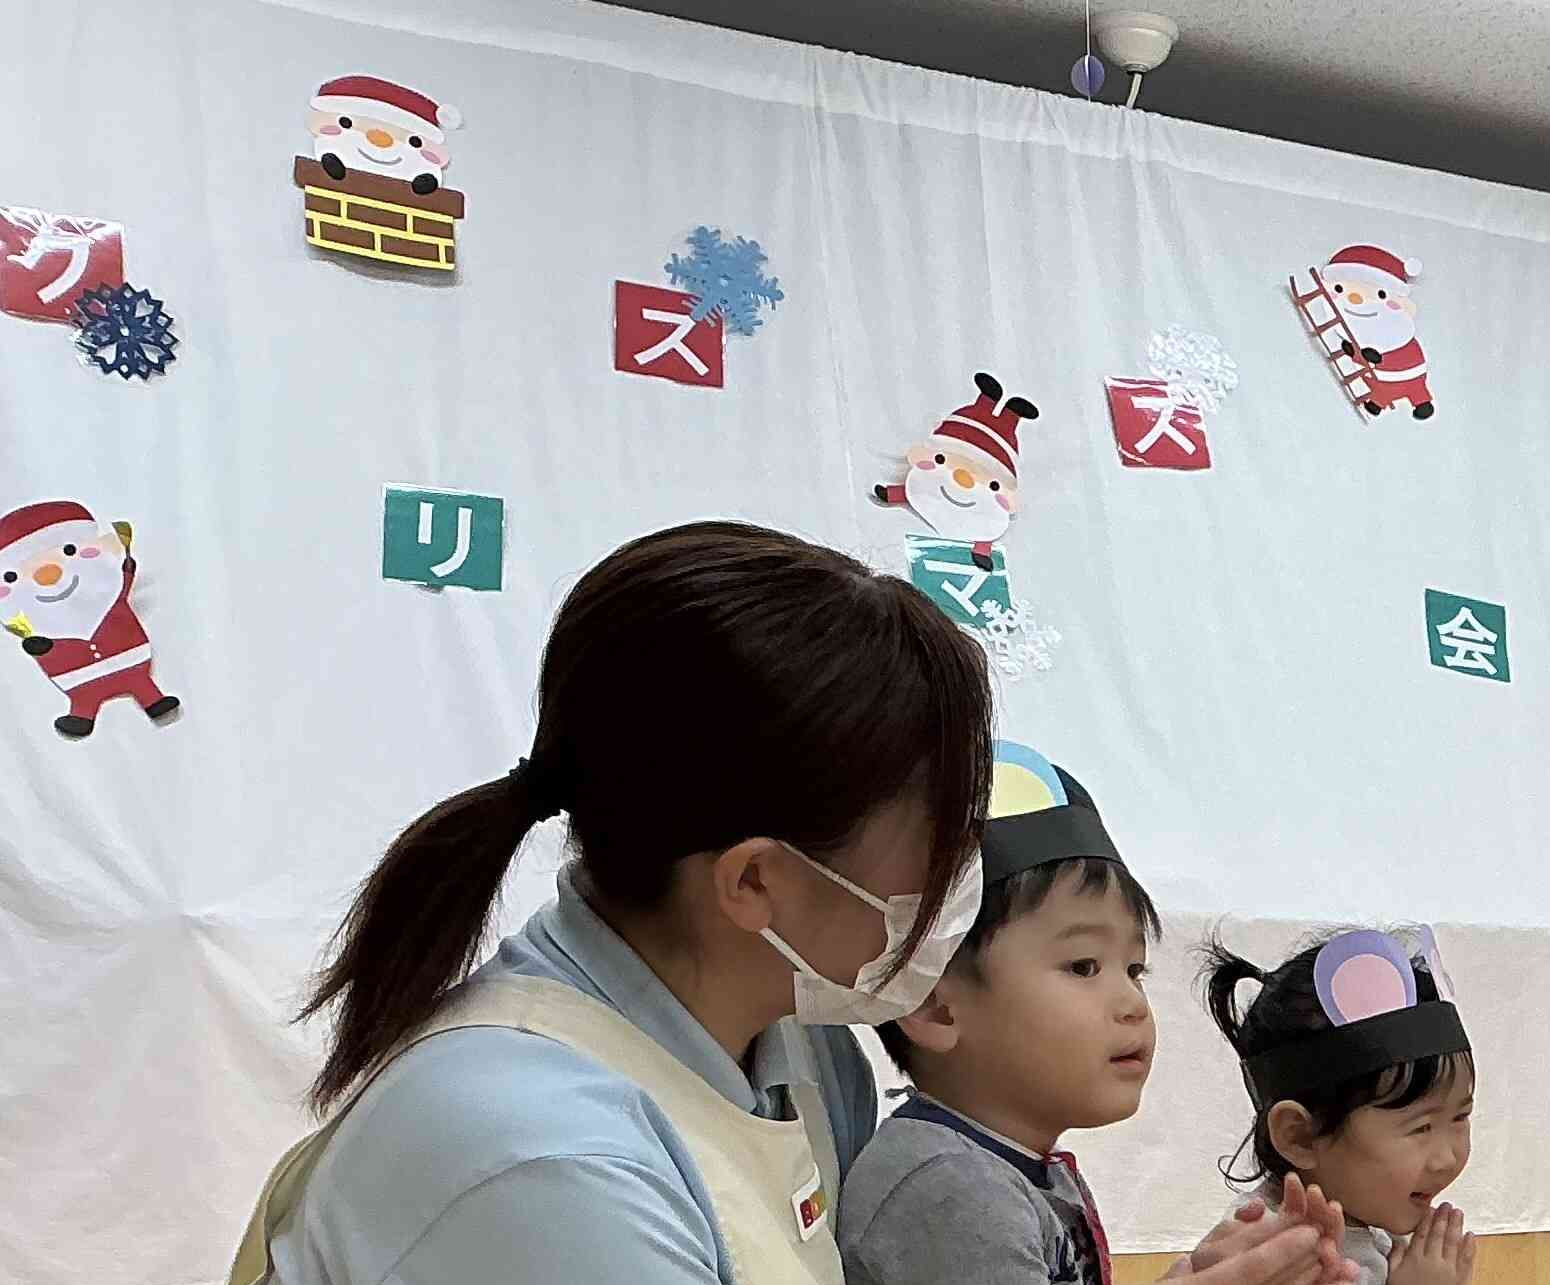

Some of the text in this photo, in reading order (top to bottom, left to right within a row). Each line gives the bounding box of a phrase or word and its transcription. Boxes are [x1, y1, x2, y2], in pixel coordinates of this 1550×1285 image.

[417, 501, 473, 577] リ
[634, 307, 710, 377] ス
[923, 560, 995, 617] マ
[1130, 396, 1197, 456] ス
[1436, 606, 1498, 675] 会
